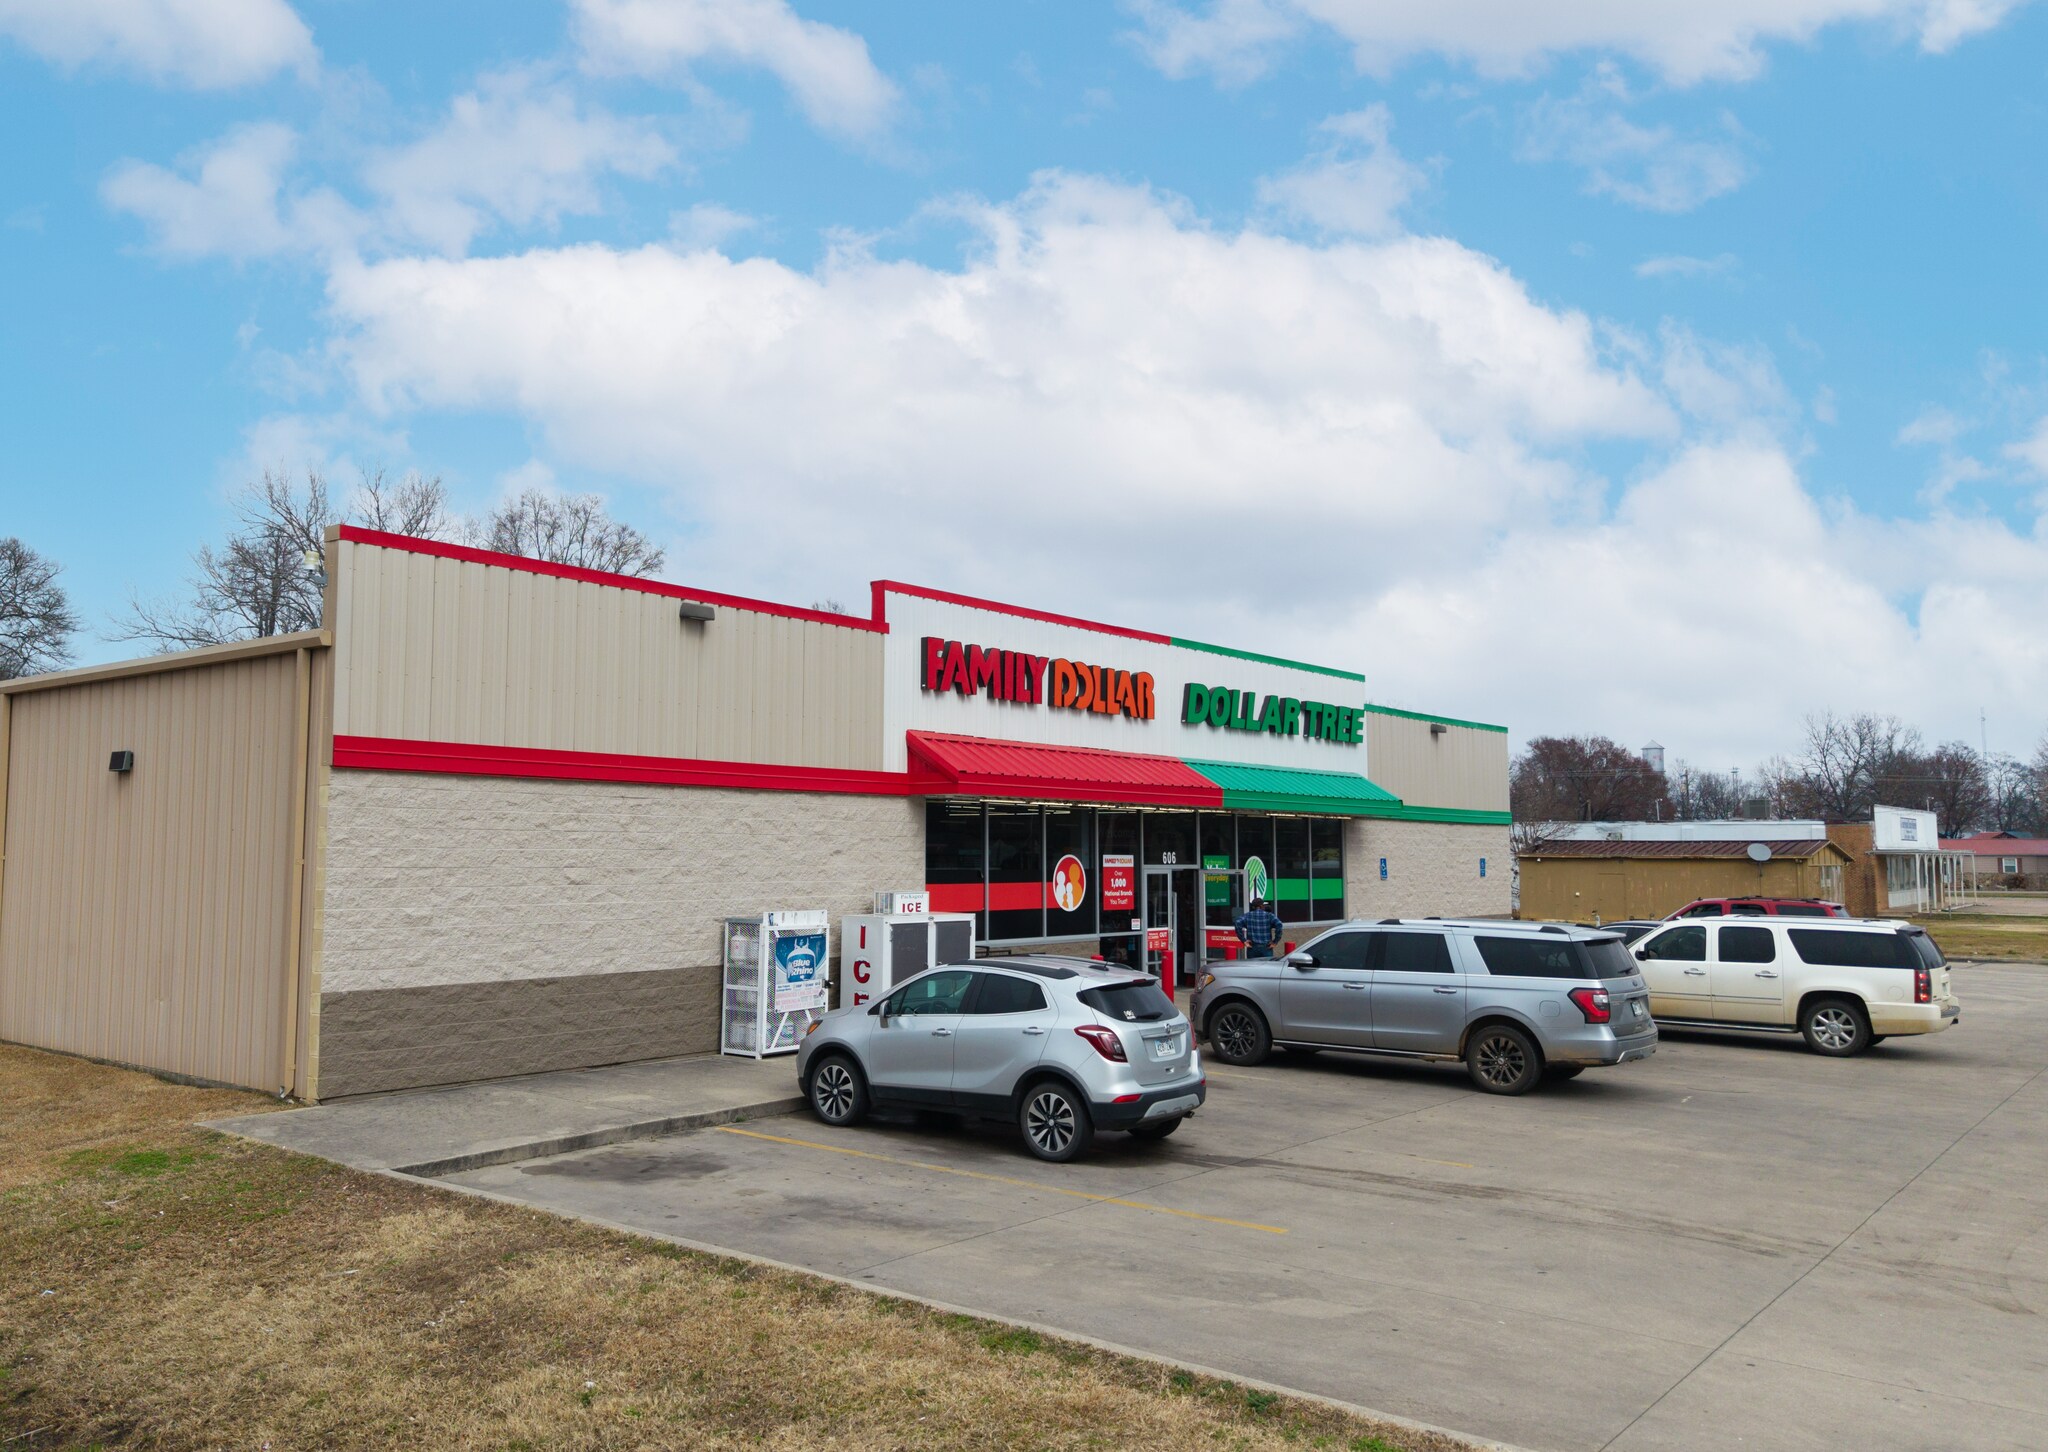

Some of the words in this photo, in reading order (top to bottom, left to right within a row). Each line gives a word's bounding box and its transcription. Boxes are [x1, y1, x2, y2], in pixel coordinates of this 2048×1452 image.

[922, 637, 1049, 704] FAMILY
[1050, 658, 1155, 720] DOLLAR
[1183, 683, 1300, 735] DOLLAR
[1303, 700, 1364, 743] TREE
[1162, 851, 1177, 864] 606
[1110, 878, 1127, 889] 1,000
[902, 902, 922, 913] ICE
[792, 959, 811, 968] Blue
[791, 966, 814, 976] Rhino
